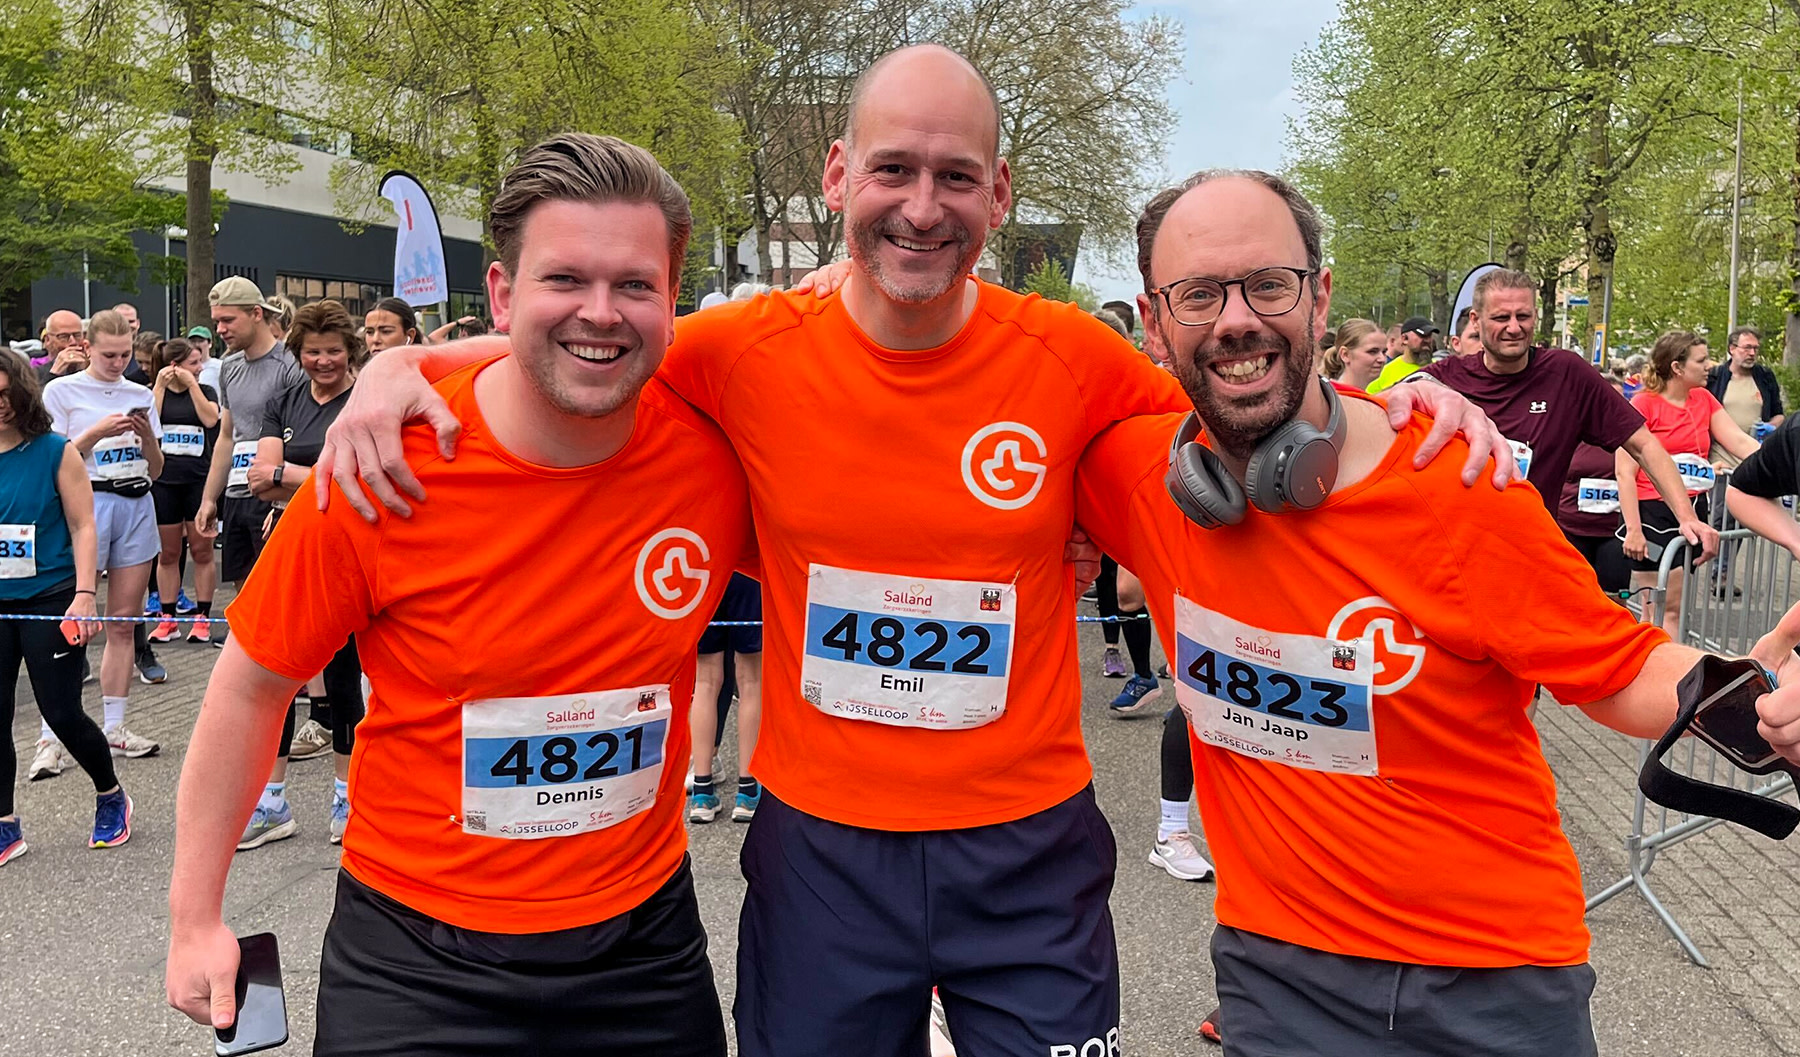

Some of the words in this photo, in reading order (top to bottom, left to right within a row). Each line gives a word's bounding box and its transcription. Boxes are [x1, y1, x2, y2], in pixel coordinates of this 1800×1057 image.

[167, 433, 199, 444] 5194
[1678, 463, 1709, 479] 5172
[1585, 488, 1619, 501] 5164
[0, 540, 26, 558] 83
[884, 590, 932, 607] Salland
[822, 612, 991, 675] 4822
[1235, 636, 1281, 659] Salland
[880, 674, 924, 693] Emil
[1188, 649, 1349, 728] 4823
[546, 708, 595, 724] Salland
[845, 704, 909, 720] IJSSELLOOP
[920, 706, 927, 718] 5
[929, 707, 946, 717] km
[1222, 707, 1254, 728] Jan
[1261, 719, 1309, 742] Jaap
[1214, 734, 1275, 756] IJSSELLOOP
[1285, 748, 1292, 758] 5
[490, 726, 644, 785] 4821
[536, 785, 604, 806] Dennis
[589, 811, 596, 822] 5
[513, 821, 579, 834] IJSSELLOOP
